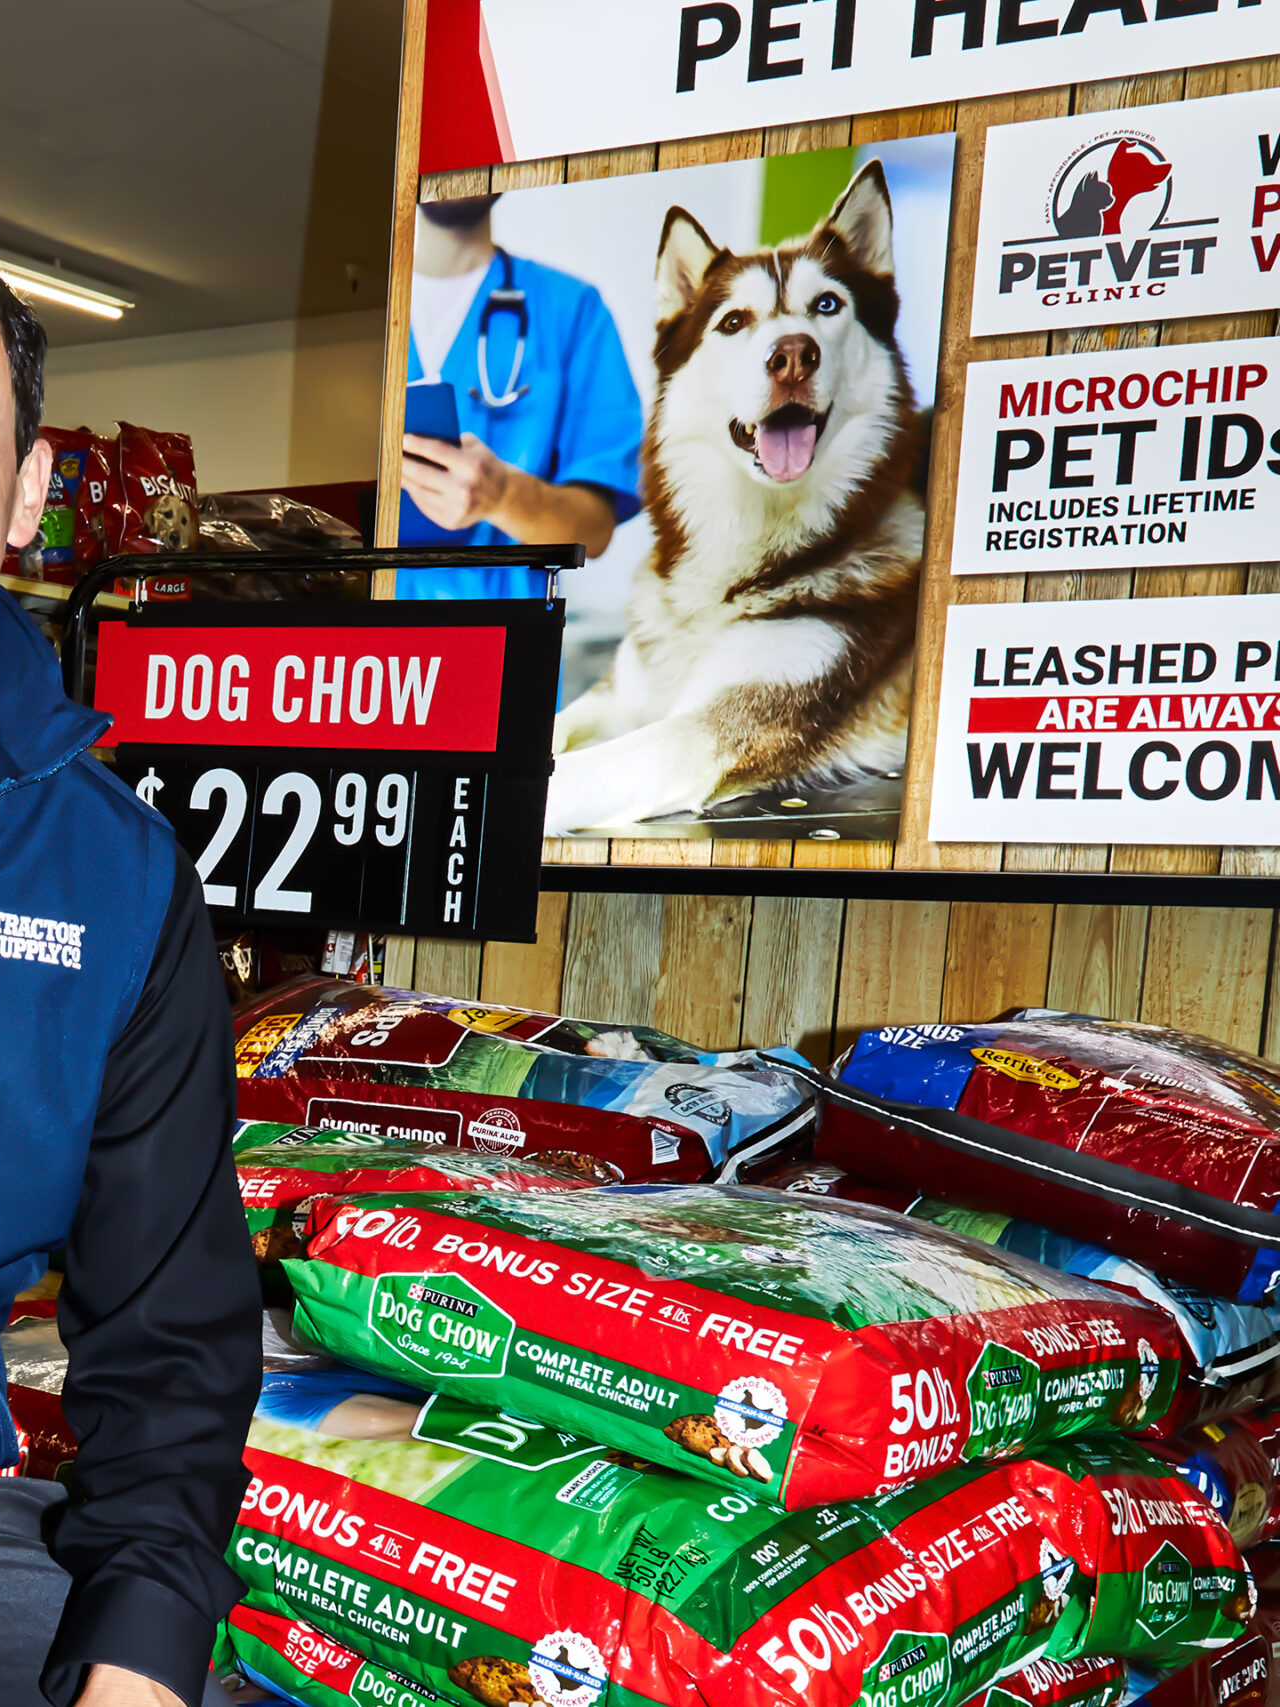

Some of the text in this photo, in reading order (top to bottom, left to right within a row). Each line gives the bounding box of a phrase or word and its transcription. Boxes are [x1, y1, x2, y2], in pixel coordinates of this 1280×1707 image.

[675, 0, 855, 93] PET
[1048, 143, 1085, 193] AFFORDABLE
[1094, 132, 1110, 141] PET
[1112, 129, 1156, 142] APPROVED
[1042, 282, 1166, 306] CLINIC
[999, 364, 1268, 419] MICROCHIP
[992, 419, 1157, 492] PET
[988, 489, 1256, 523] INCLUDES LIFETIME
[986, 522, 1187, 552] REGISTRATION
[155, 582, 185, 592] LARGE
[974, 642, 1217, 686] LEASHED
[144, 655, 441, 725] DOG CHOW
[1036, 697, 1119, 730] ARE
[967, 740, 1280, 801] WELCOM
[444, 778, 470, 922] EACH
[879, 1026, 929, 1050] SIZE
[980, 1048, 1071, 1087] Retriever
[1131, 1093, 1175, 1106] HEARTY
[1177, 1103, 1206, 1115] BEEF
[1208, 1112, 1250, 1129] FLAVOR
[472, 1127, 519, 1142] PURINA ALPO
[423, 1291, 475, 1316] PURINA
[432, 1234, 560, 1286] BONUS
[563, 1272, 654, 1317] SIZE
[659, 1305, 672, 1318] 4
[698, 1313, 804, 1367] FREE
[378, 1292, 501, 1358] DOG CHOW
[1022, 1319, 1126, 1357] BONUS FREE
[397, 1334, 471, 1370] Since 1926
[515, 1340, 680, 1410] COMPLETE ADULT
[535, 1363, 650, 1413] WITH REAL CHICKEN
[735, 1380, 781, 1404] MADE WITH
[990, 1366, 1020, 1387] PURINA
[889, 1368, 960, 1435] 50lb.
[734, 1431, 772, 1444] CHICKEN
[884, 1432, 958, 1477] BONUS
[562, 1462, 605, 1498] SMART CHOICE
[241, 1477, 517, 1613] BONUS 4 FREE
[614, 1525, 658, 1579] NET WT
[632, 1548, 670, 1588] 50 LB
[235, 1536, 468, 1649] COMPLETE ADULT
[274, 1578, 411, 1645] WITH REAL CHICKEN
[757, 1495, 1033, 1694] 50lb. BONUS SIZE FRE
[287, 1628, 351, 1670] BONUS
[549, 1636, 599, 1663] MADE WITH
[952, 1614, 998, 1660] COMPLETE
[963, 1620, 1018, 1664] WITH REAL CHICKEN
[283, 1643, 319, 1675] SIZE
[532, 1654, 602, 1688] AMERICAN-RAISED
[890, 1648, 926, 1675] PURINA
[901, 1656, 947, 1702] CHOW
[358, 1669, 397, 1705] DOG
[534, 1674, 589, 1707] REAL CHICKEN
